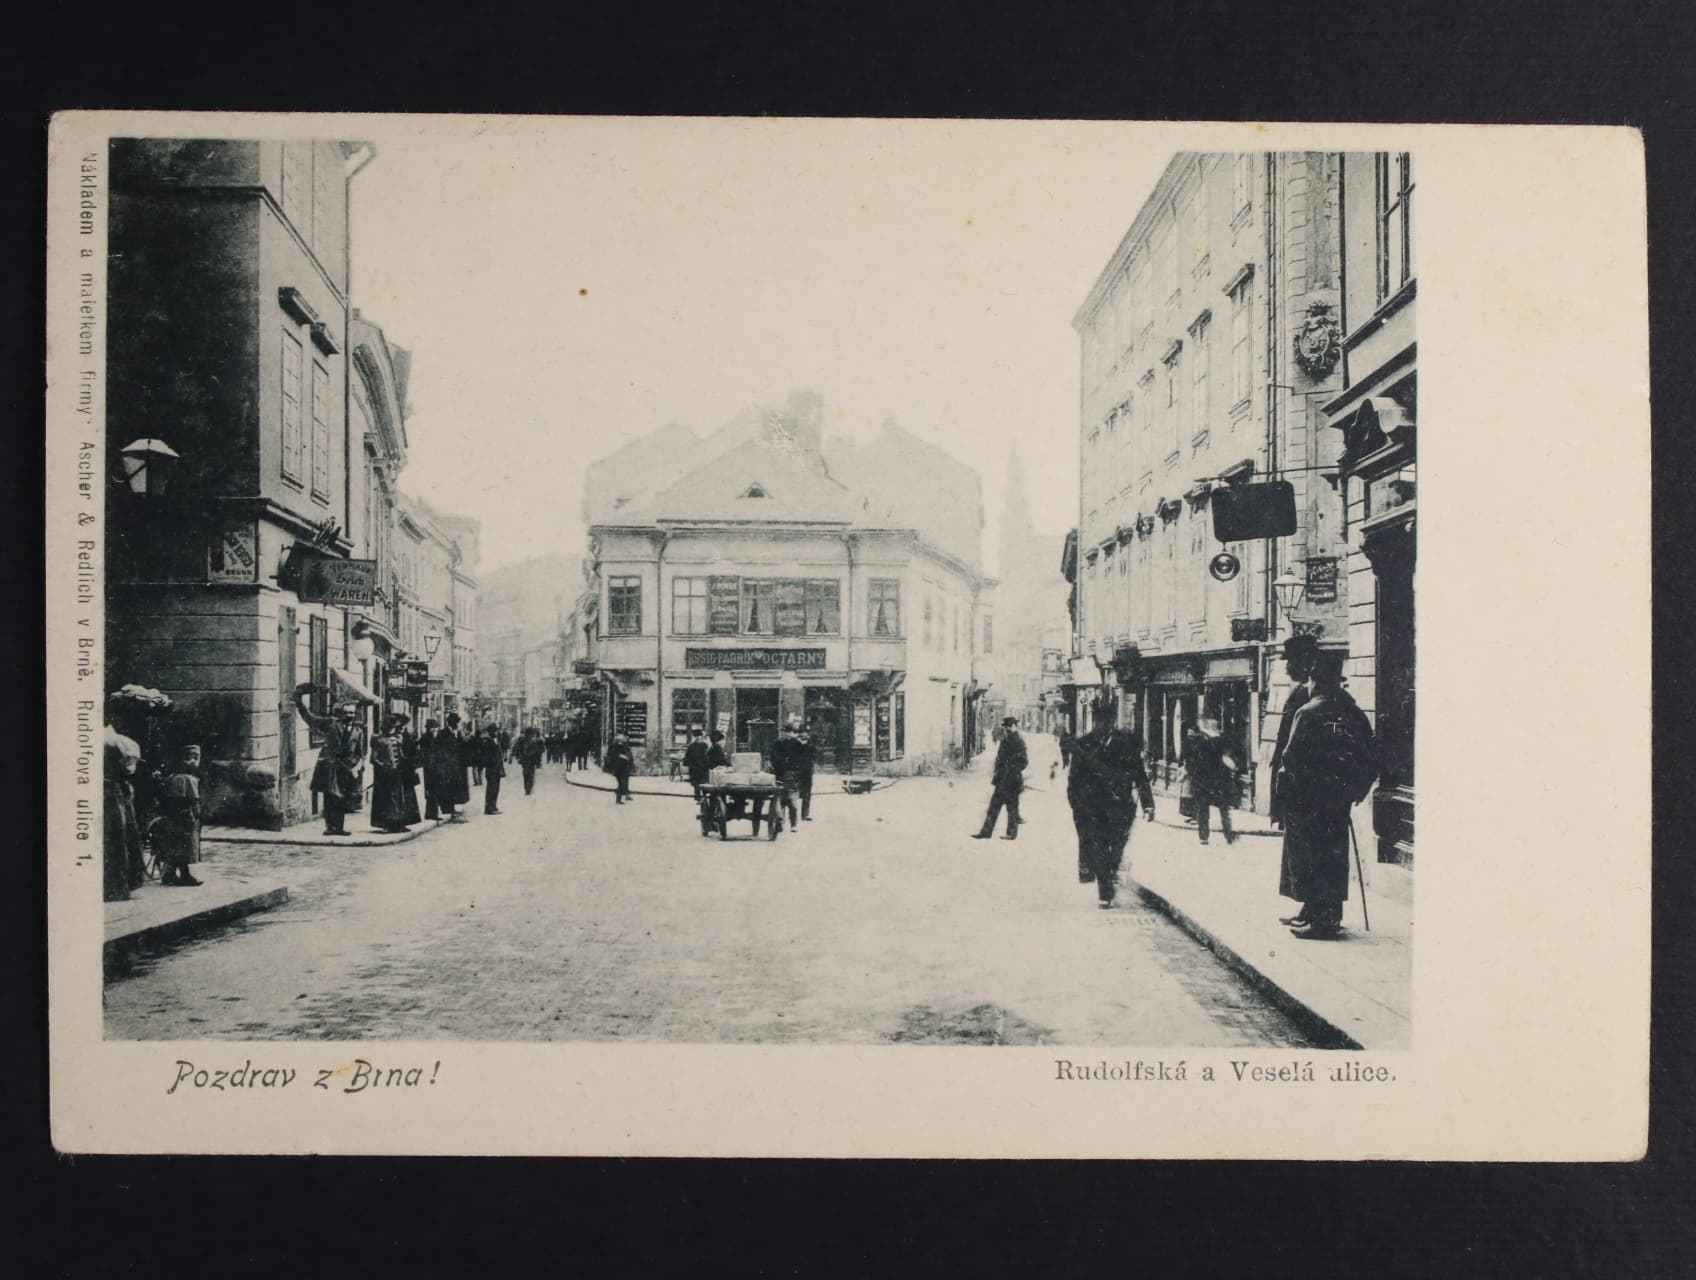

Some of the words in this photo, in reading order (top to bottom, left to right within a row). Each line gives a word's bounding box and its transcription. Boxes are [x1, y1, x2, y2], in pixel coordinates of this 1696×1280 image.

[80, 249, 93, 259] a
[79, 441, 96, 501] Ascher
[78, 513, 95, 527] &
[77, 540, 95, 604] Redlich
[77, 618, 91, 628] v
[77, 699, 95, 785] Rudolfova
[76, 799, 93, 841] ulice
[167, 1060, 296, 1094] Pozdrav
[313, 1068, 335, 1090] z
[343, 1059, 441, 1094] Brna!
[1055, 1060, 1187, 1081] Rudolfská
[1202, 1066, 1216, 1082] a
[1229, 1060, 1315, 1082] Veselá
